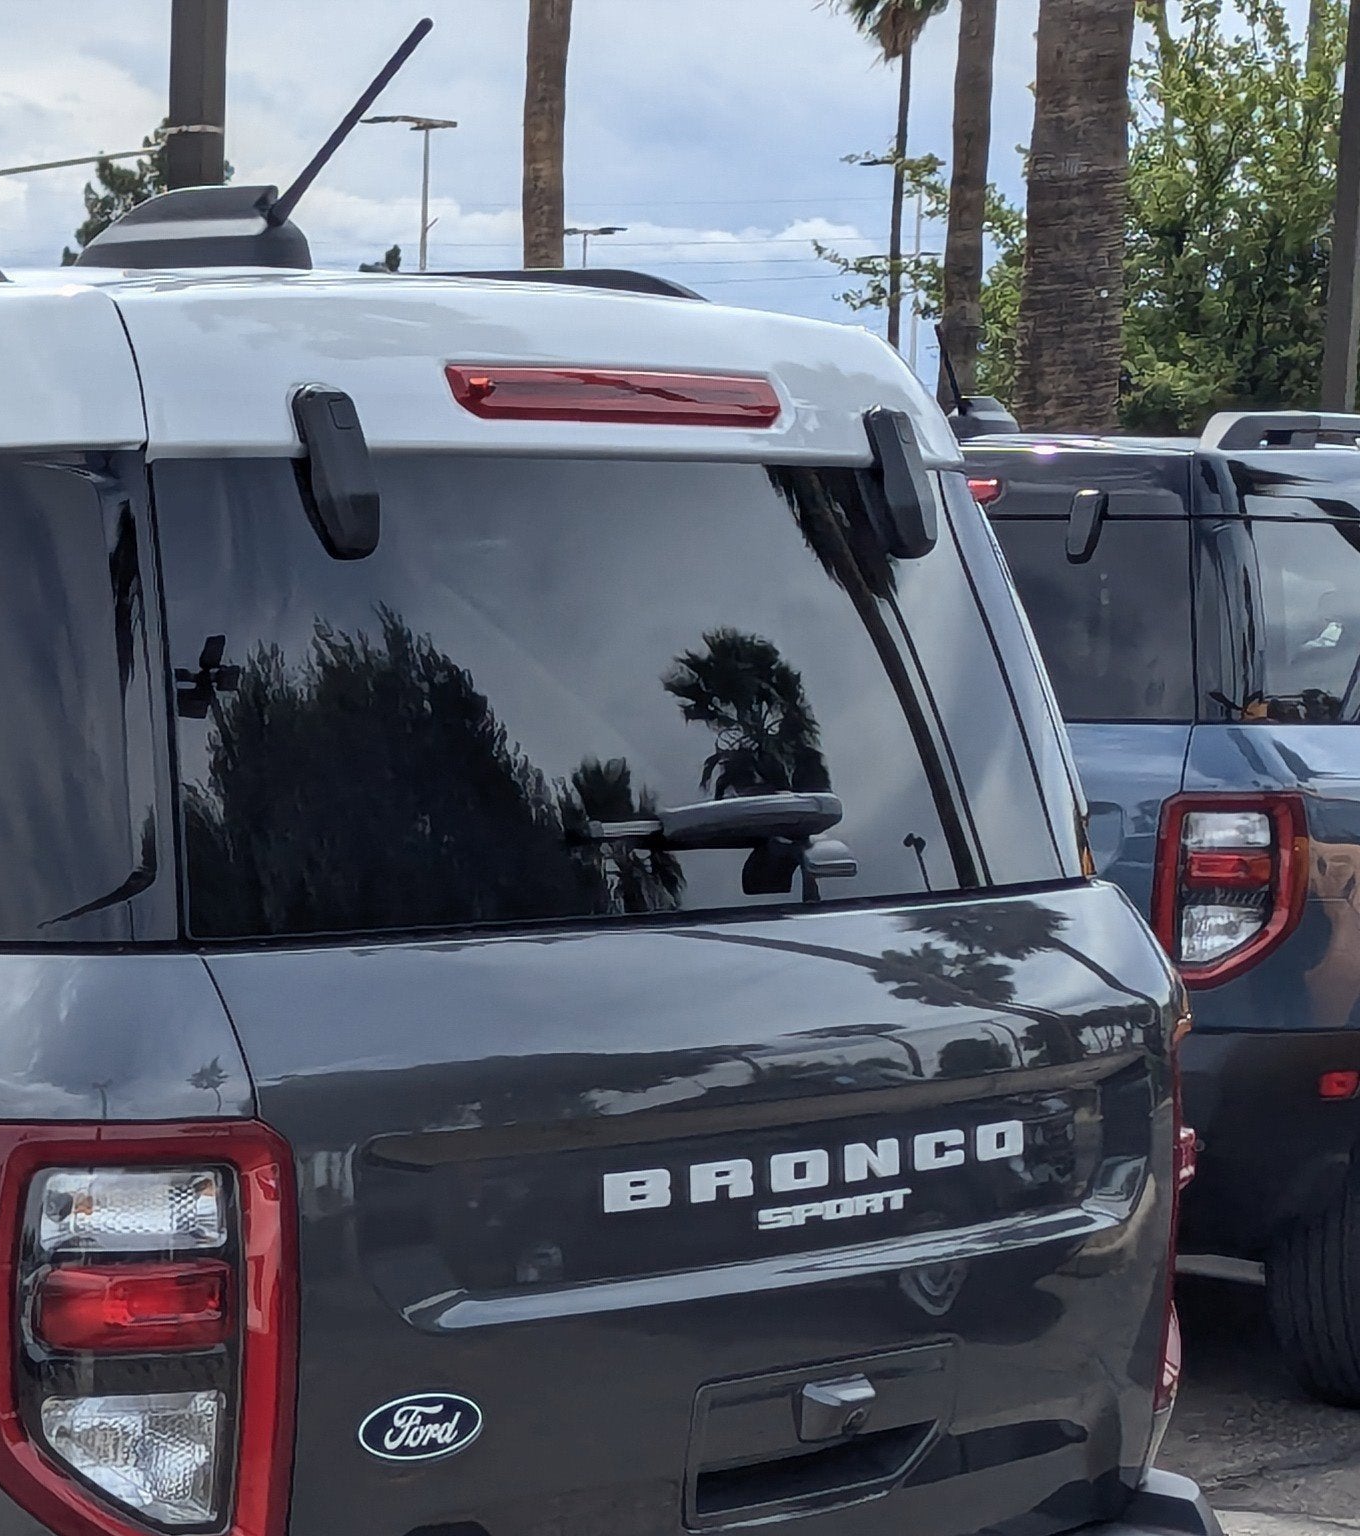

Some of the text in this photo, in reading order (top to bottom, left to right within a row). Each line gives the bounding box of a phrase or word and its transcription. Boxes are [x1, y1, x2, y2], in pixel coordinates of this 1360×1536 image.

[602, 1119, 1024, 1213] BRONCO
[757, 1187, 912, 1231] SPORT
[383, 1403, 462, 1450] Ford
